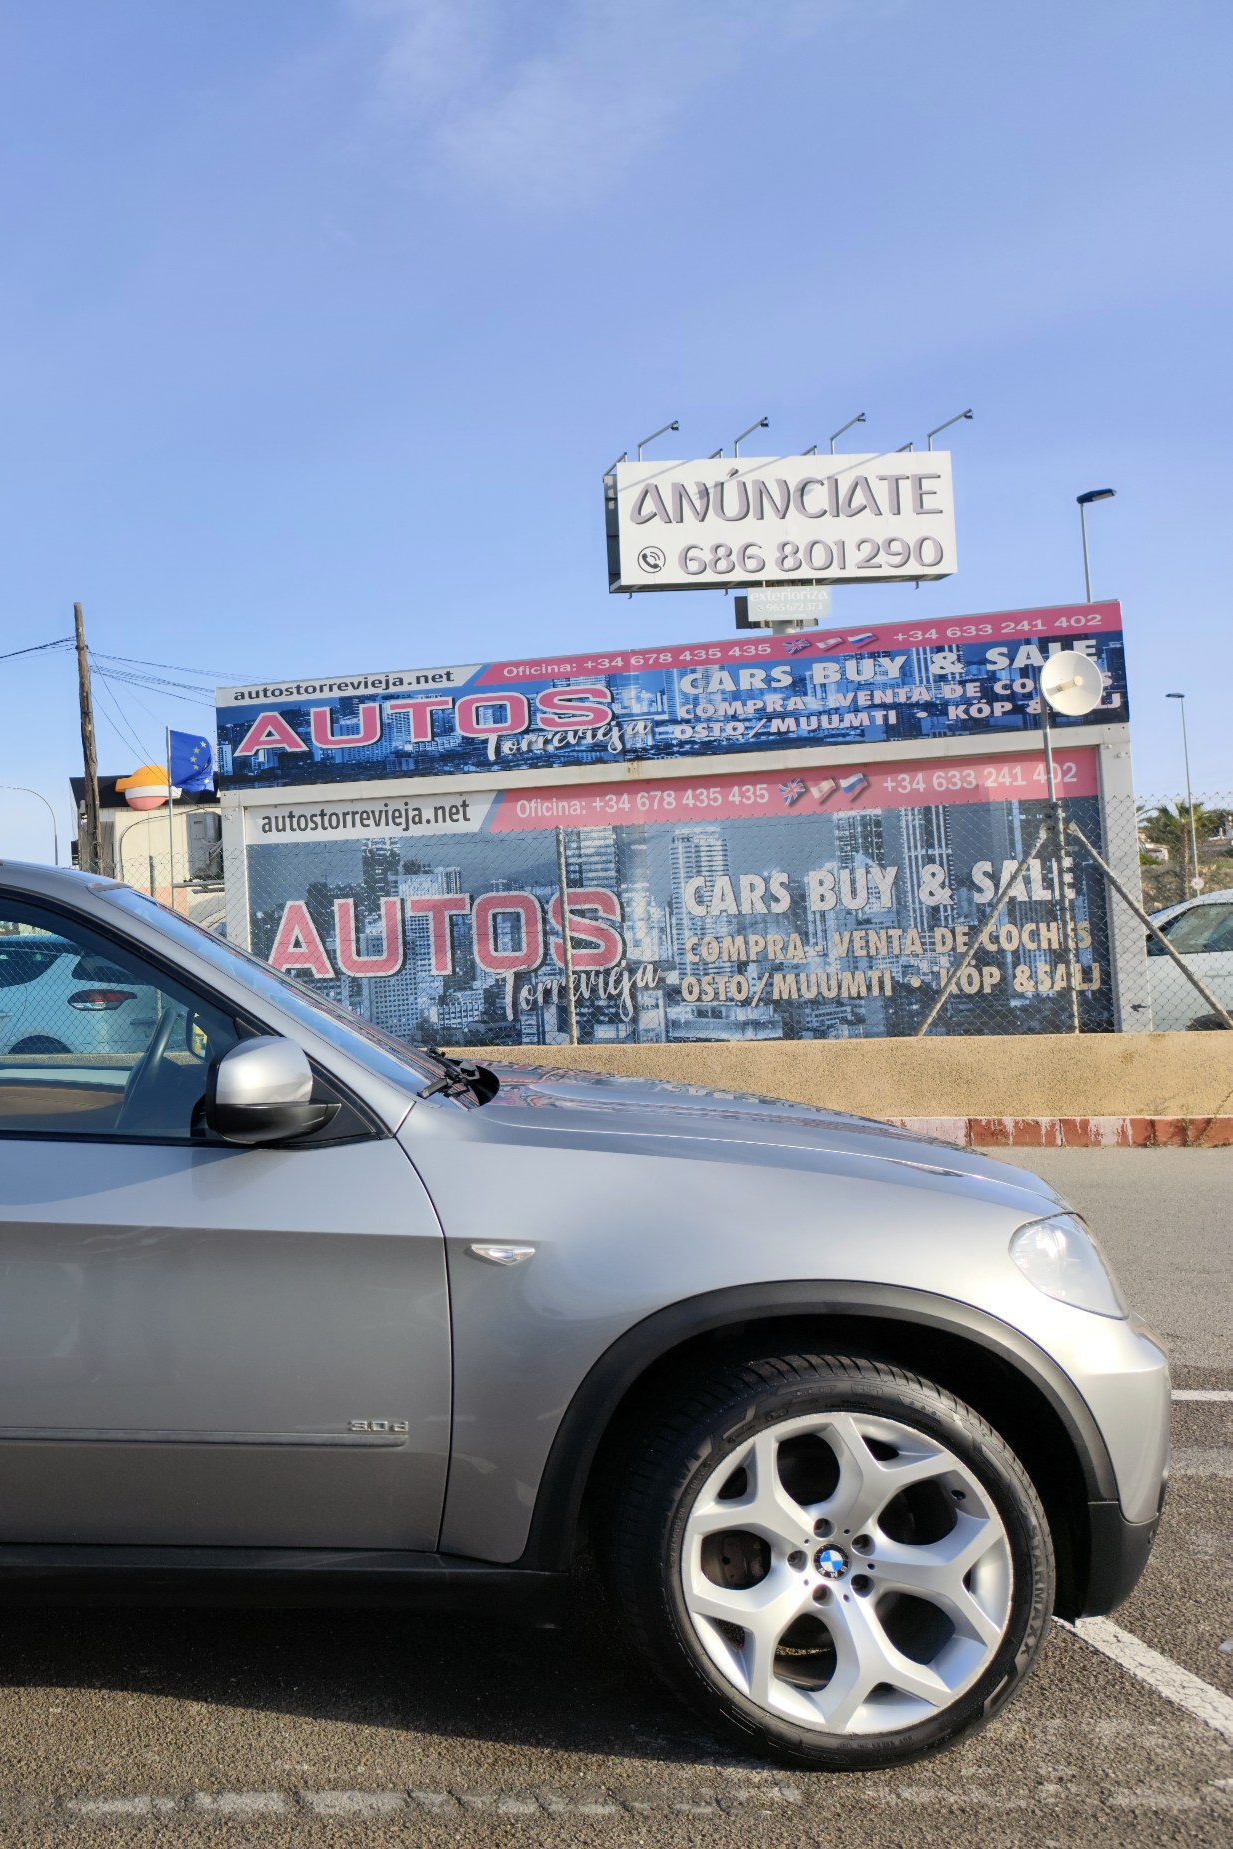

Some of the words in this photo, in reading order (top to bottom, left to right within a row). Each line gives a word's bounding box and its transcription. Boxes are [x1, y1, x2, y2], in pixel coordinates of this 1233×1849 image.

[629, 468, 943, 524] ANÚNCIATE
[679, 541, 766, 575] 686
[775, 538, 846, 572] 801
[855, 535, 944, 569] 290
[750, 588, 829, 602] exterioriza
[893, 627, 939, 642] +34
[946, 622, 994, 638] 633
[1001, 617, 1042, 634] 241
[1055, 614, 1102, 629] 402
[503, 660, 578, 677] Oficina:
[583, 655, 624, 670] +34
[630, 651, 673, 667] 678
[678, 647, 722, 661] 435
[727, 643, 772, 658] 435
[679, 664, 793, 694] CARS
[812, 656, 908, 686] BUY
[930, 651, 965, 675] &
[233, 670, 455, 701] autostorrevieja.net
[678, 697, 805, 719] COMPRA
[833, 686, 937, 708] VENTA
[942, 681, 982, 699] DE
[234, 685, 613, 757] AUTOS
[948, 695, 1014, 720] KÖP
[486, 719, 653, 762] Torrevieja
[883, 774, 926, 795] +34
[933, 770, 976, 792] 633
[984, 767, 1027, 788] 241
[1033, 763, 1077, 784] 402
[261, 799, 471, 834] autostorrevieja.net
[517, 796, 586, 818] Oficina:
[592, 793, 630, 814] +34
[636, 790, 676, 811] 678
[682, 787, 722, 808] 435
[728, 783, 769, 805] 435
[685, 872, 792, 917] CARS
[808, 865, 898, 912] BUY
[917, 862, 954, 906] &
[972, 856, 1076, 904] SALE
[268, 888, 625, 979] AUTOS
[686, 934, 805, 963] COMPRA
[833, 927, 920, 958] VENTA
[936, 925, 969, 953] DE
[982, 920, 1092, 951] COCHES
[488, 960, 662, 1021] Torrevieja
